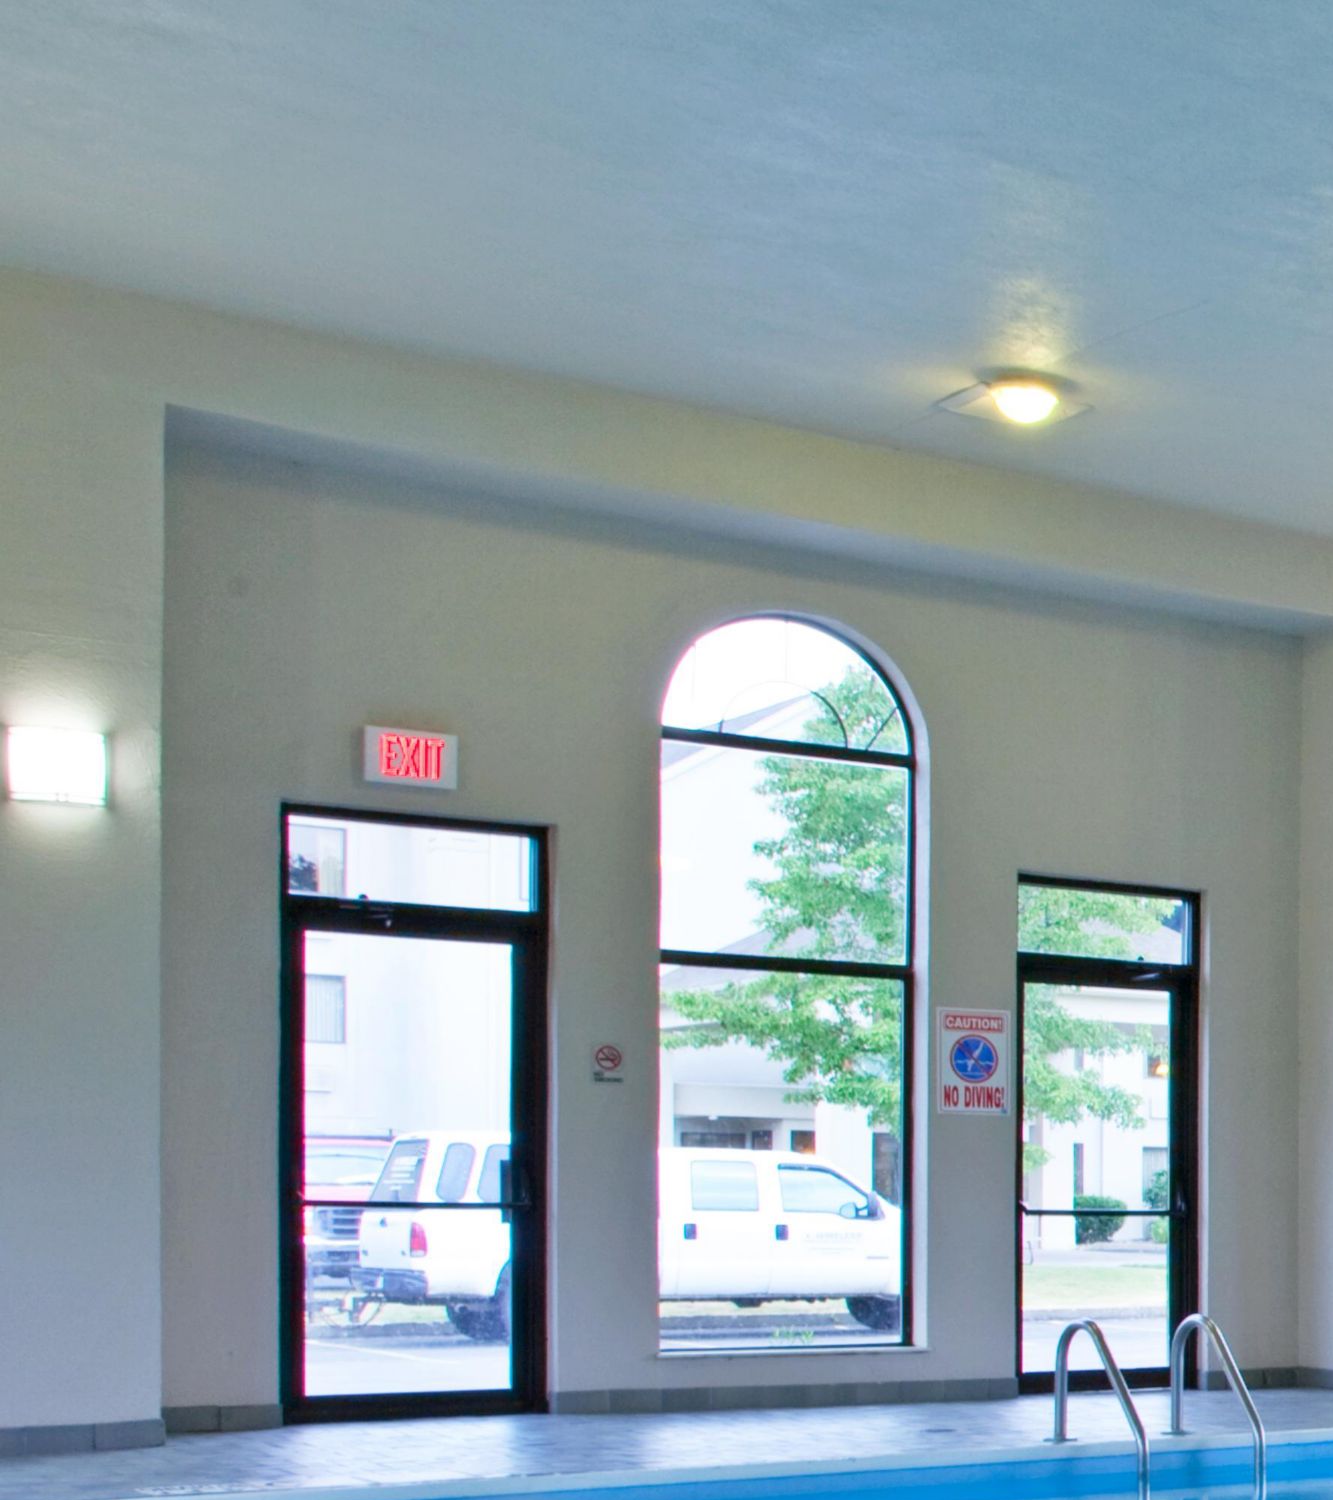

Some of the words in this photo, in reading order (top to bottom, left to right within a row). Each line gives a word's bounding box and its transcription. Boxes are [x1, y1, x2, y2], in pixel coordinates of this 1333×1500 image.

[379, 733, 445, 781] EXIT
[946, 1016, 1002, 1030] CAUTION!
[944, 1086, 959, 1108] NO
[964, 1086, 1005, 1109] DIVING!
